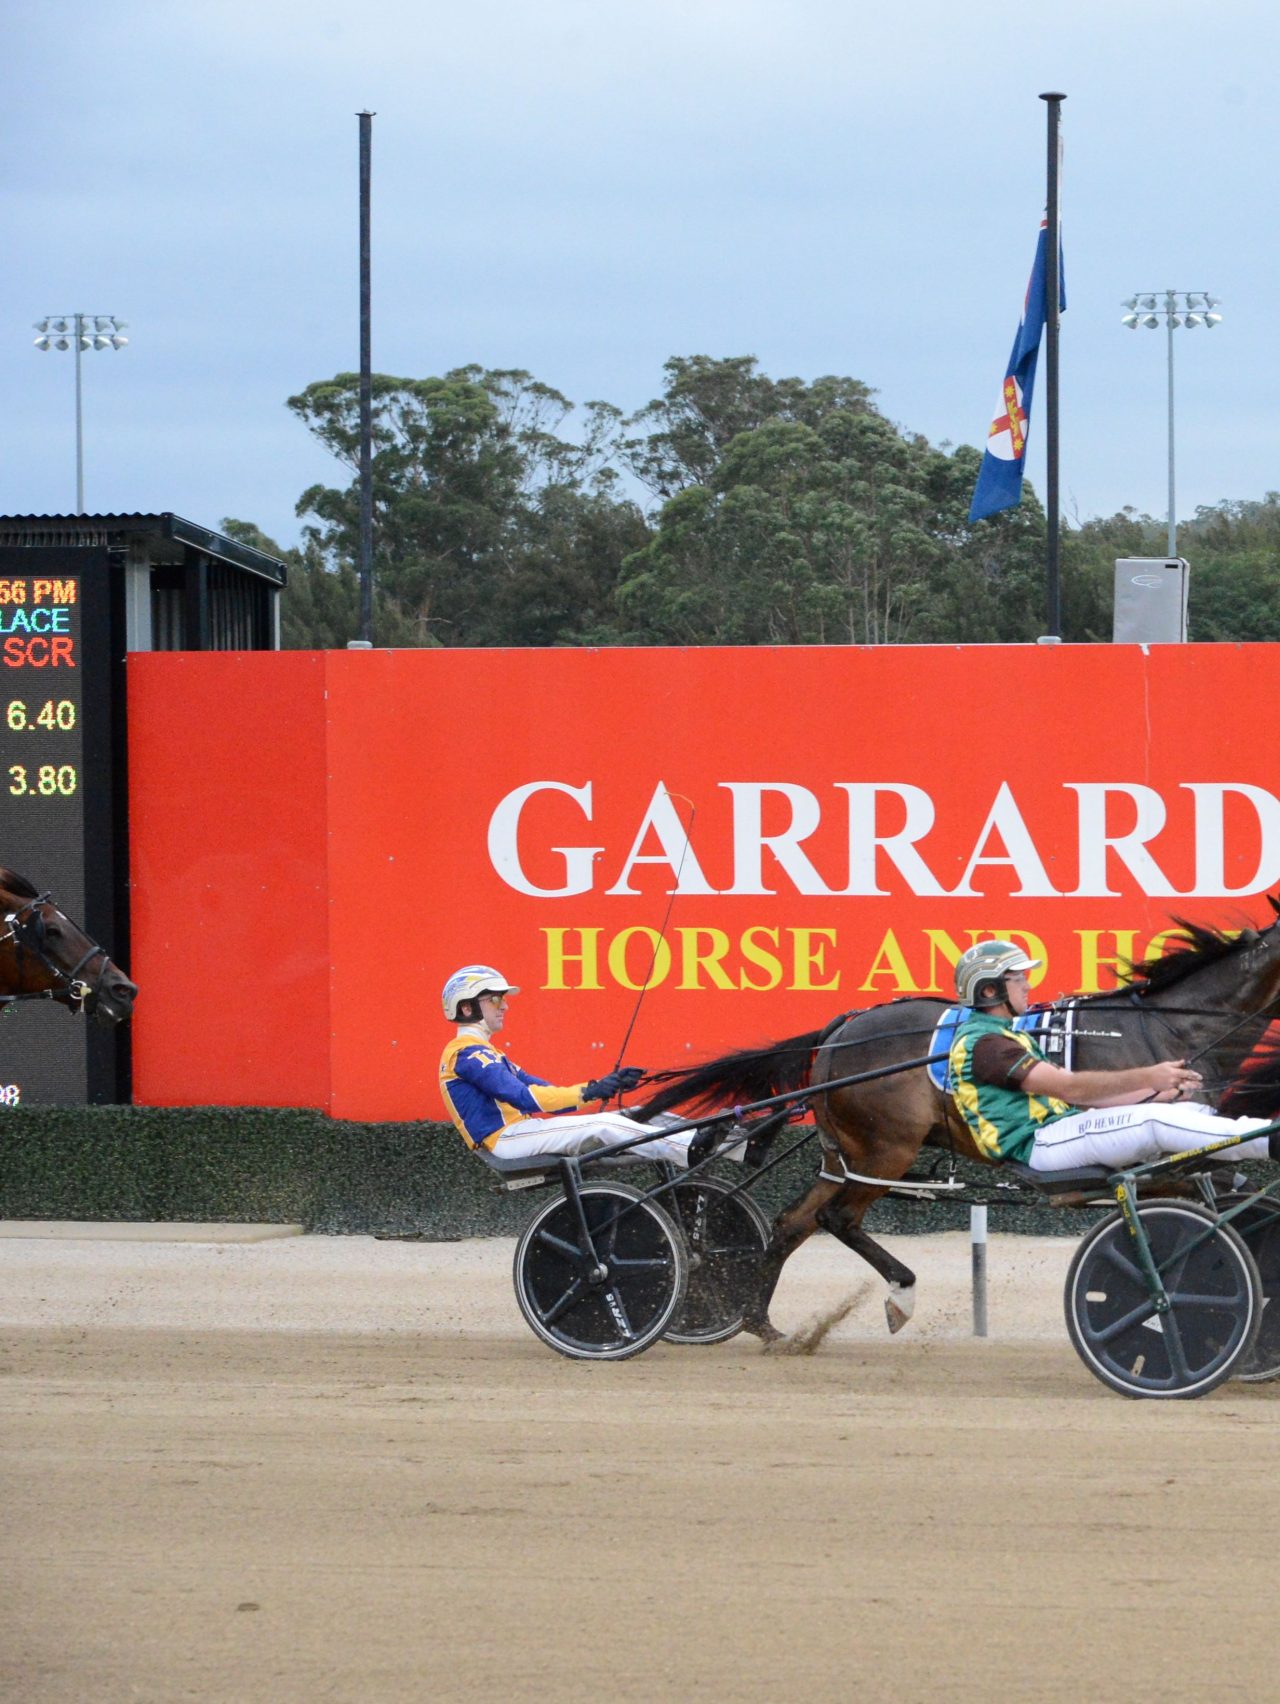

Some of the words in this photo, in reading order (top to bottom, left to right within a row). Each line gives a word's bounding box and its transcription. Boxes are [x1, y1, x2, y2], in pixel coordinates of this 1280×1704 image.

[33, 579, 77, 605] PM
[3, 636, 76, 668] SCR
[7, 700, 76, 731] 6.40
[8, 765, 77, 795] 3.80
[539, 926, 841, 992] HORSE
[858, 928, 1049, 993] AND
